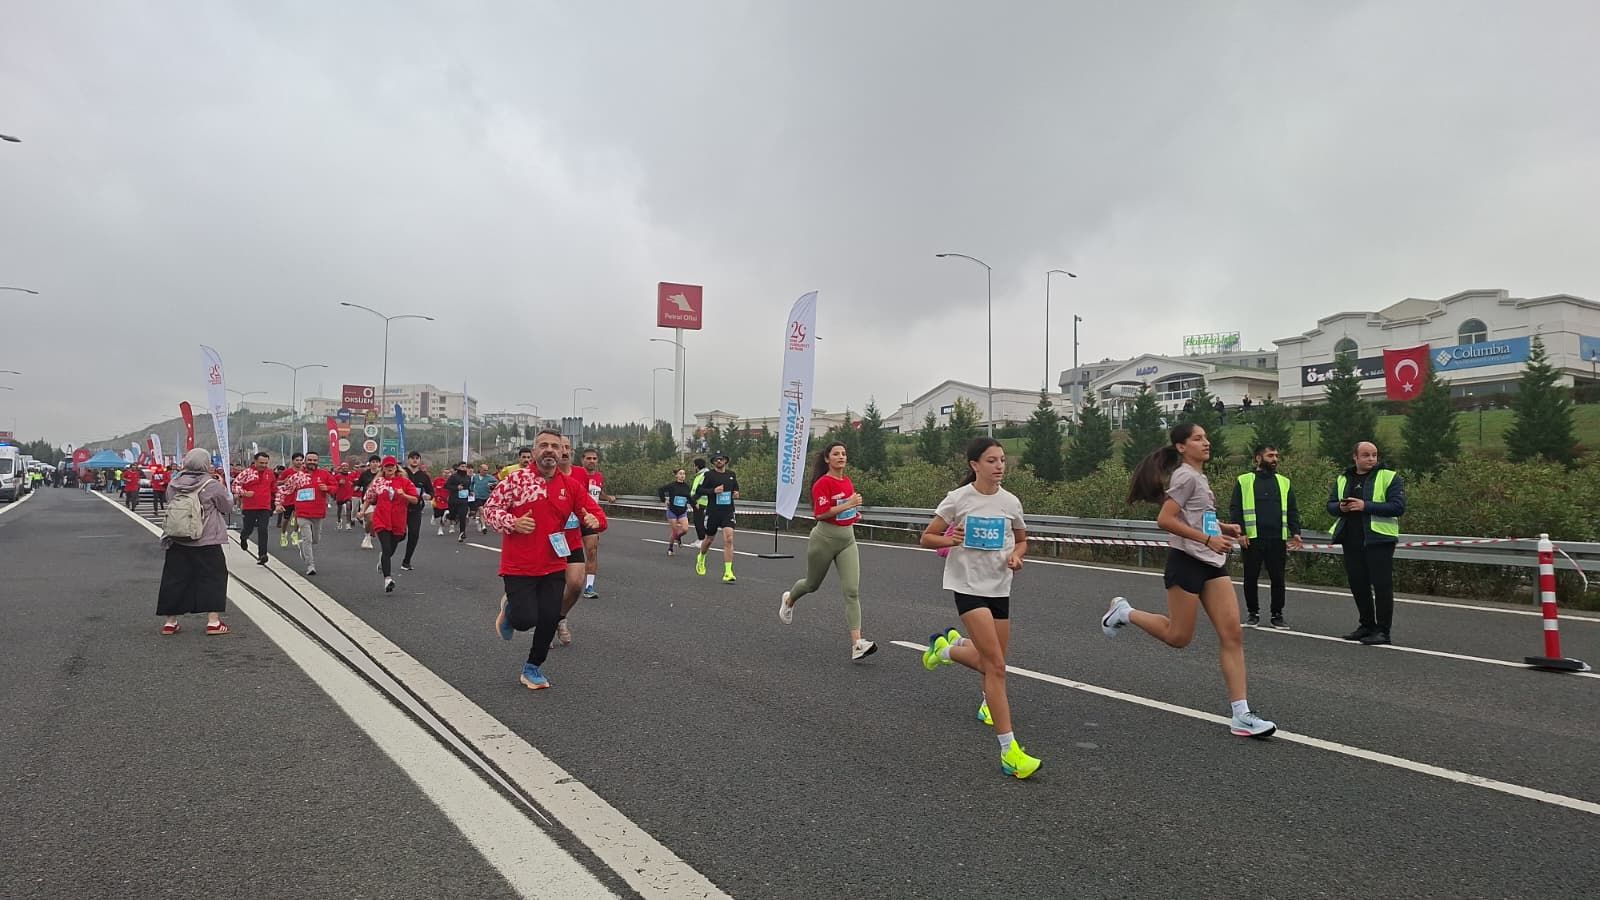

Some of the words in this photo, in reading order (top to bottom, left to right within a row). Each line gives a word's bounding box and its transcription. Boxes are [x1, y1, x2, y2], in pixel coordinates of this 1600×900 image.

[791, 321, 806, 343] 29
[1452, 343, 1509, 360] Columbia
[972, 527, 999, 539] 3365
